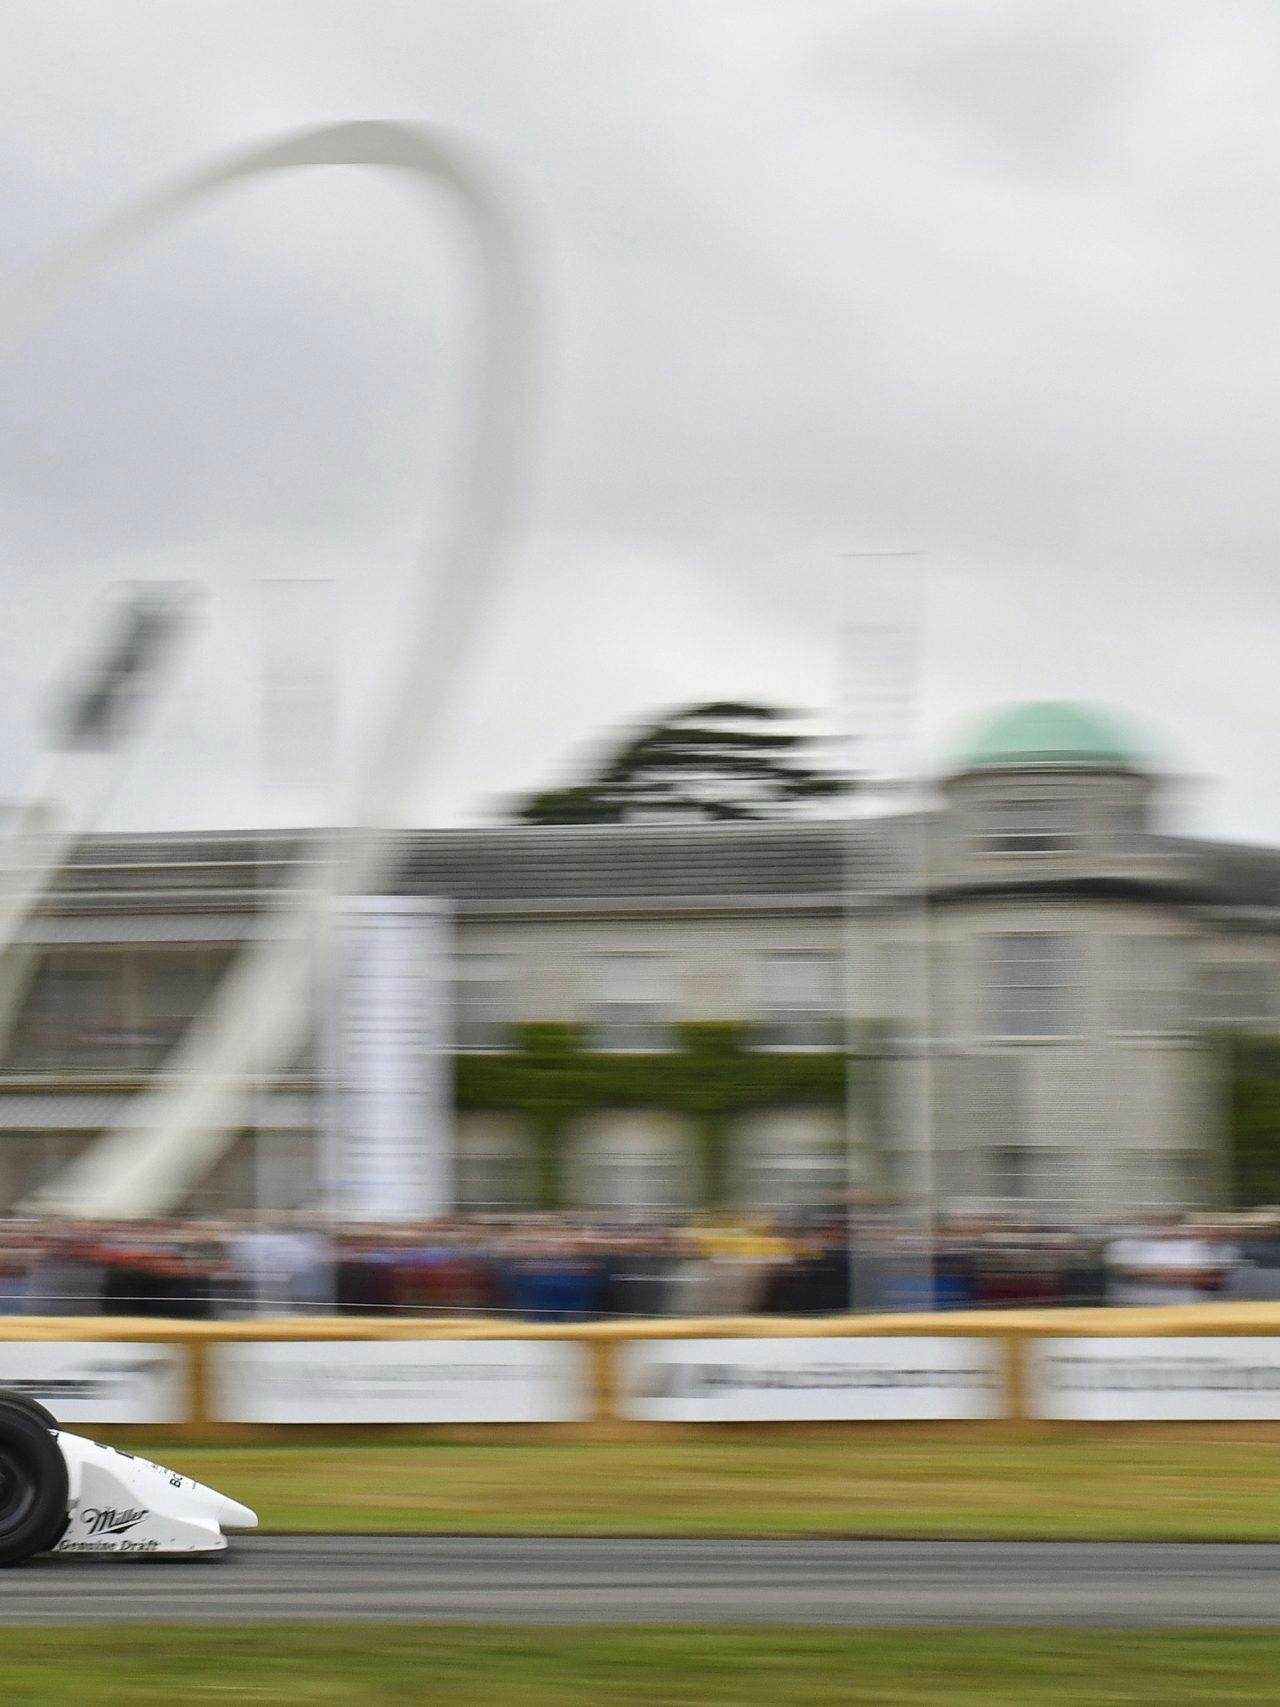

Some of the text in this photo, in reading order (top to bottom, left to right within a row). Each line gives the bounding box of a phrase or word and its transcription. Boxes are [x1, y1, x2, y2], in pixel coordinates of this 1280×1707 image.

[81, 1507, 150, 1535] Miller
[60, 1540, 160, 1551] Genuine Draft
